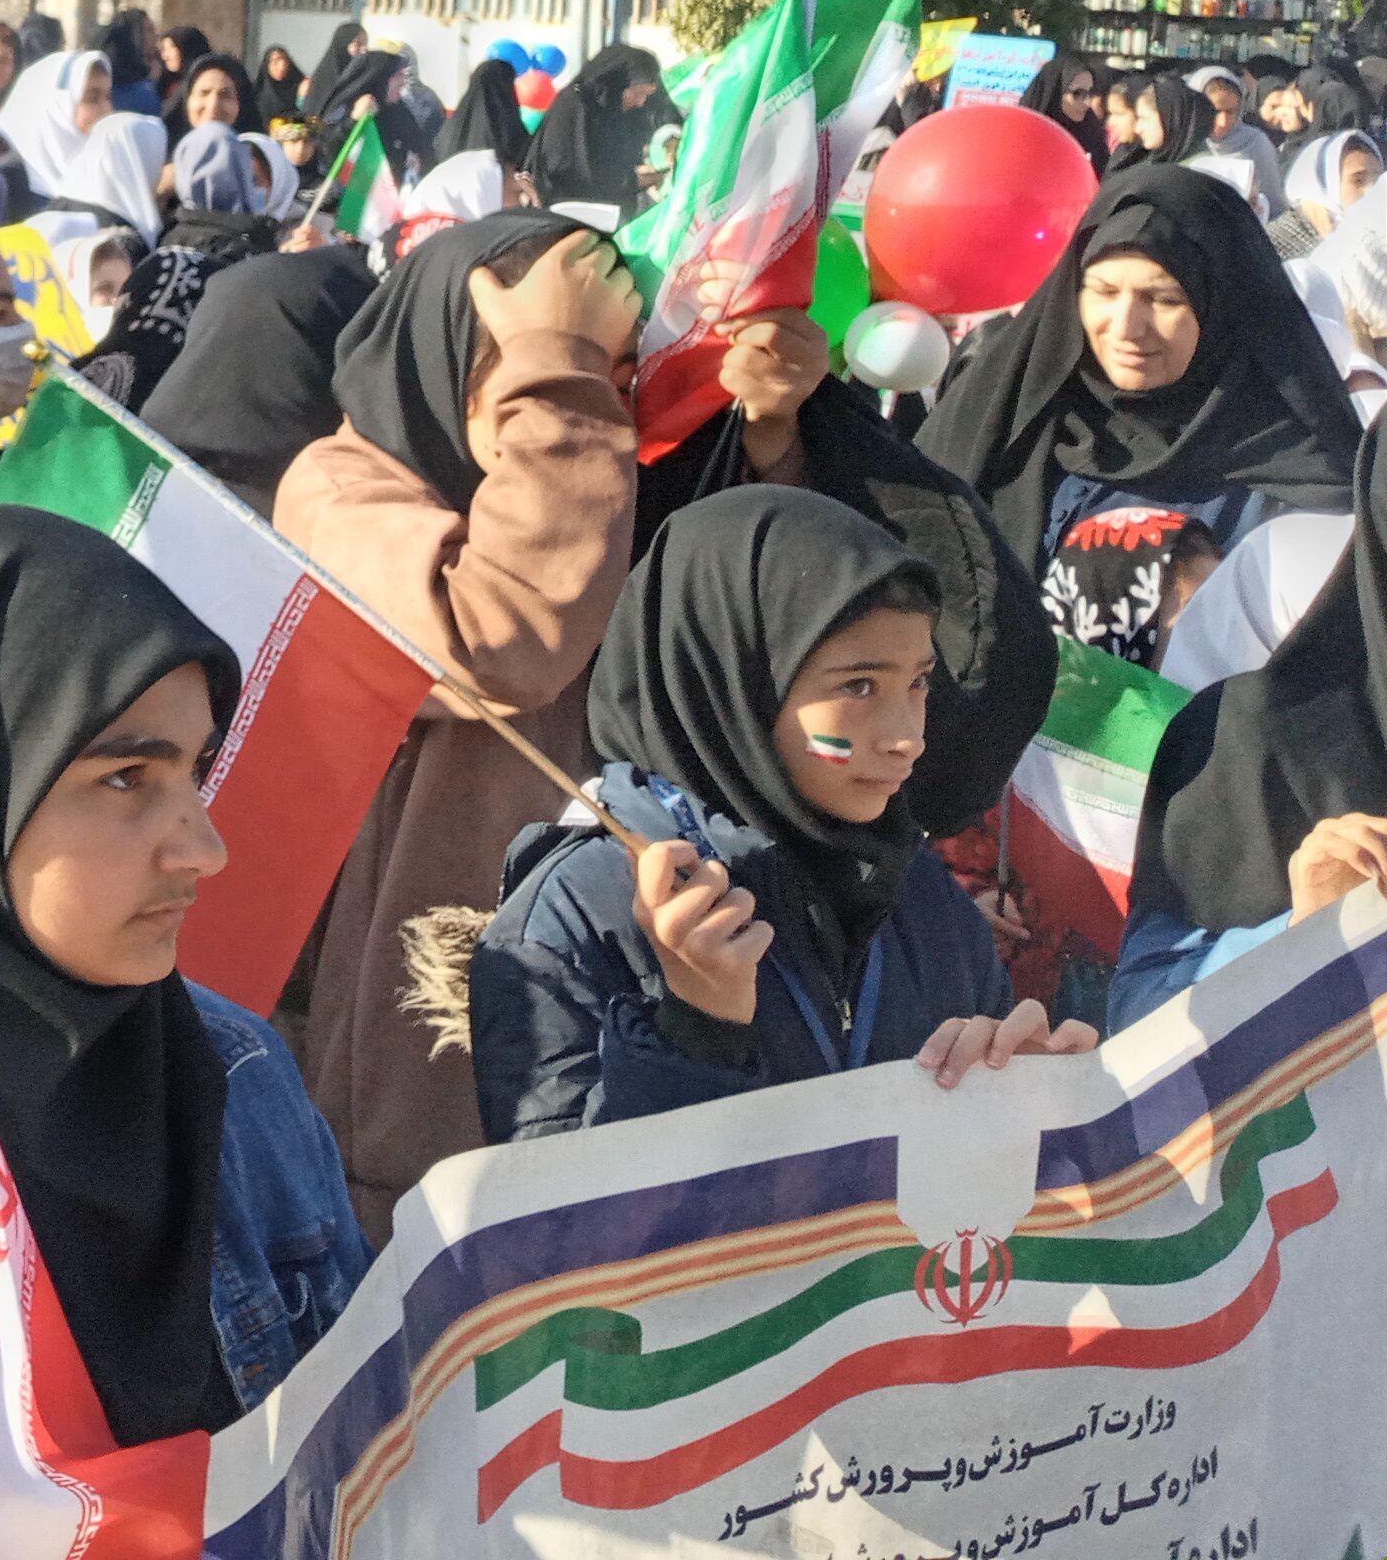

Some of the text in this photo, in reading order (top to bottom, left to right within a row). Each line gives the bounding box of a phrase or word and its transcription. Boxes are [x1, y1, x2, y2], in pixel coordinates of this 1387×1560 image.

[968, 1401, 1106, 1481] آموزش
[1103, 1393, 1178, 1441] وزارت
[717, 1462, 825, 1541] کشور
[827, 1455, 952, 1504] پرورش
[1100, 1469, 1168, 1527] کل
[1167, 1444, 1218, 1507] اداره
[980, 1481, 1102, 1560] آموزش
